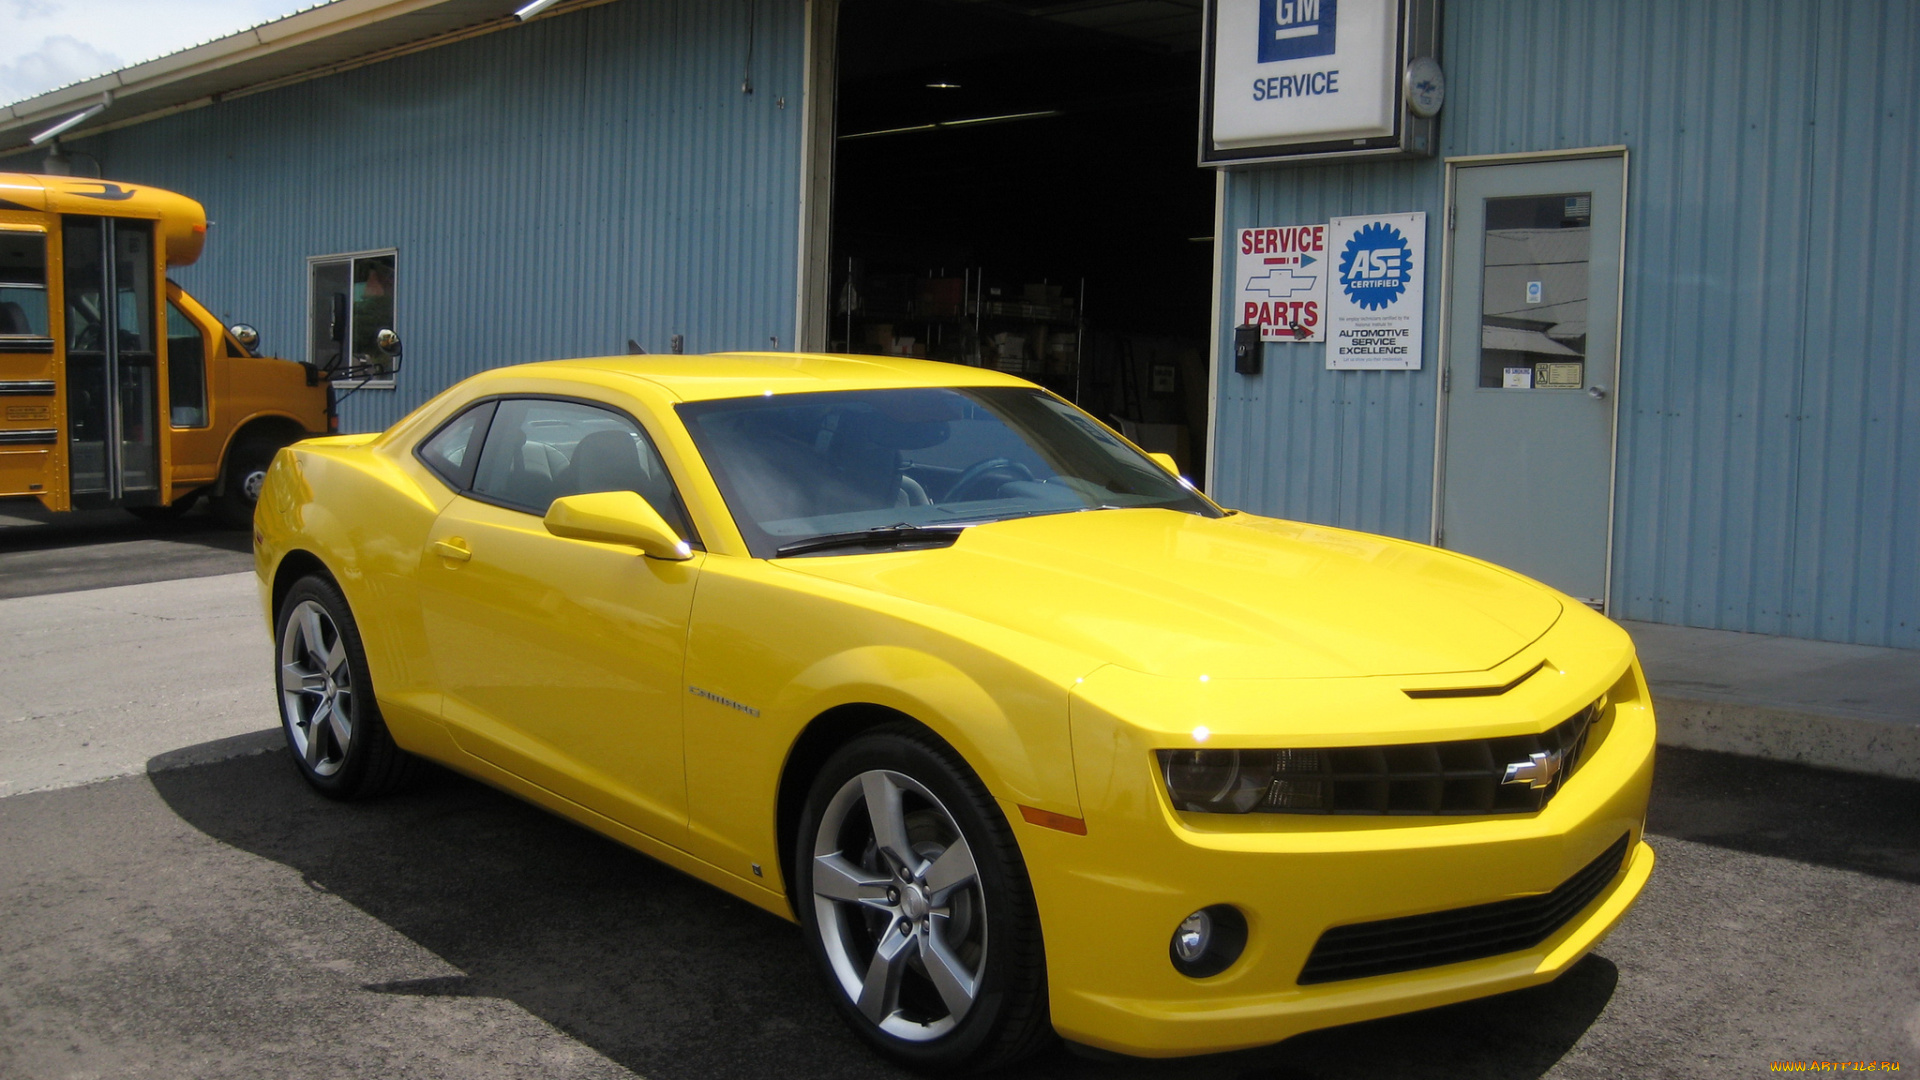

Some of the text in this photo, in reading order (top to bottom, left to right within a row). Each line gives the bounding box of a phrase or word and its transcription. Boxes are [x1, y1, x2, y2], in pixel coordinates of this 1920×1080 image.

[1276, 0, 1320, 25] GM
[1253, 70, 1340, 101] SERVICE
[1241, 226, 1324, 255] SERVICE
[1347, 248, 1401, 279] ASE
[1351, 279, 1399, 288] CERTIFIED
[1243, 301, 1318, 327] PARTS
[1339, 329, 1409, 337] AUTOMOTIVE
